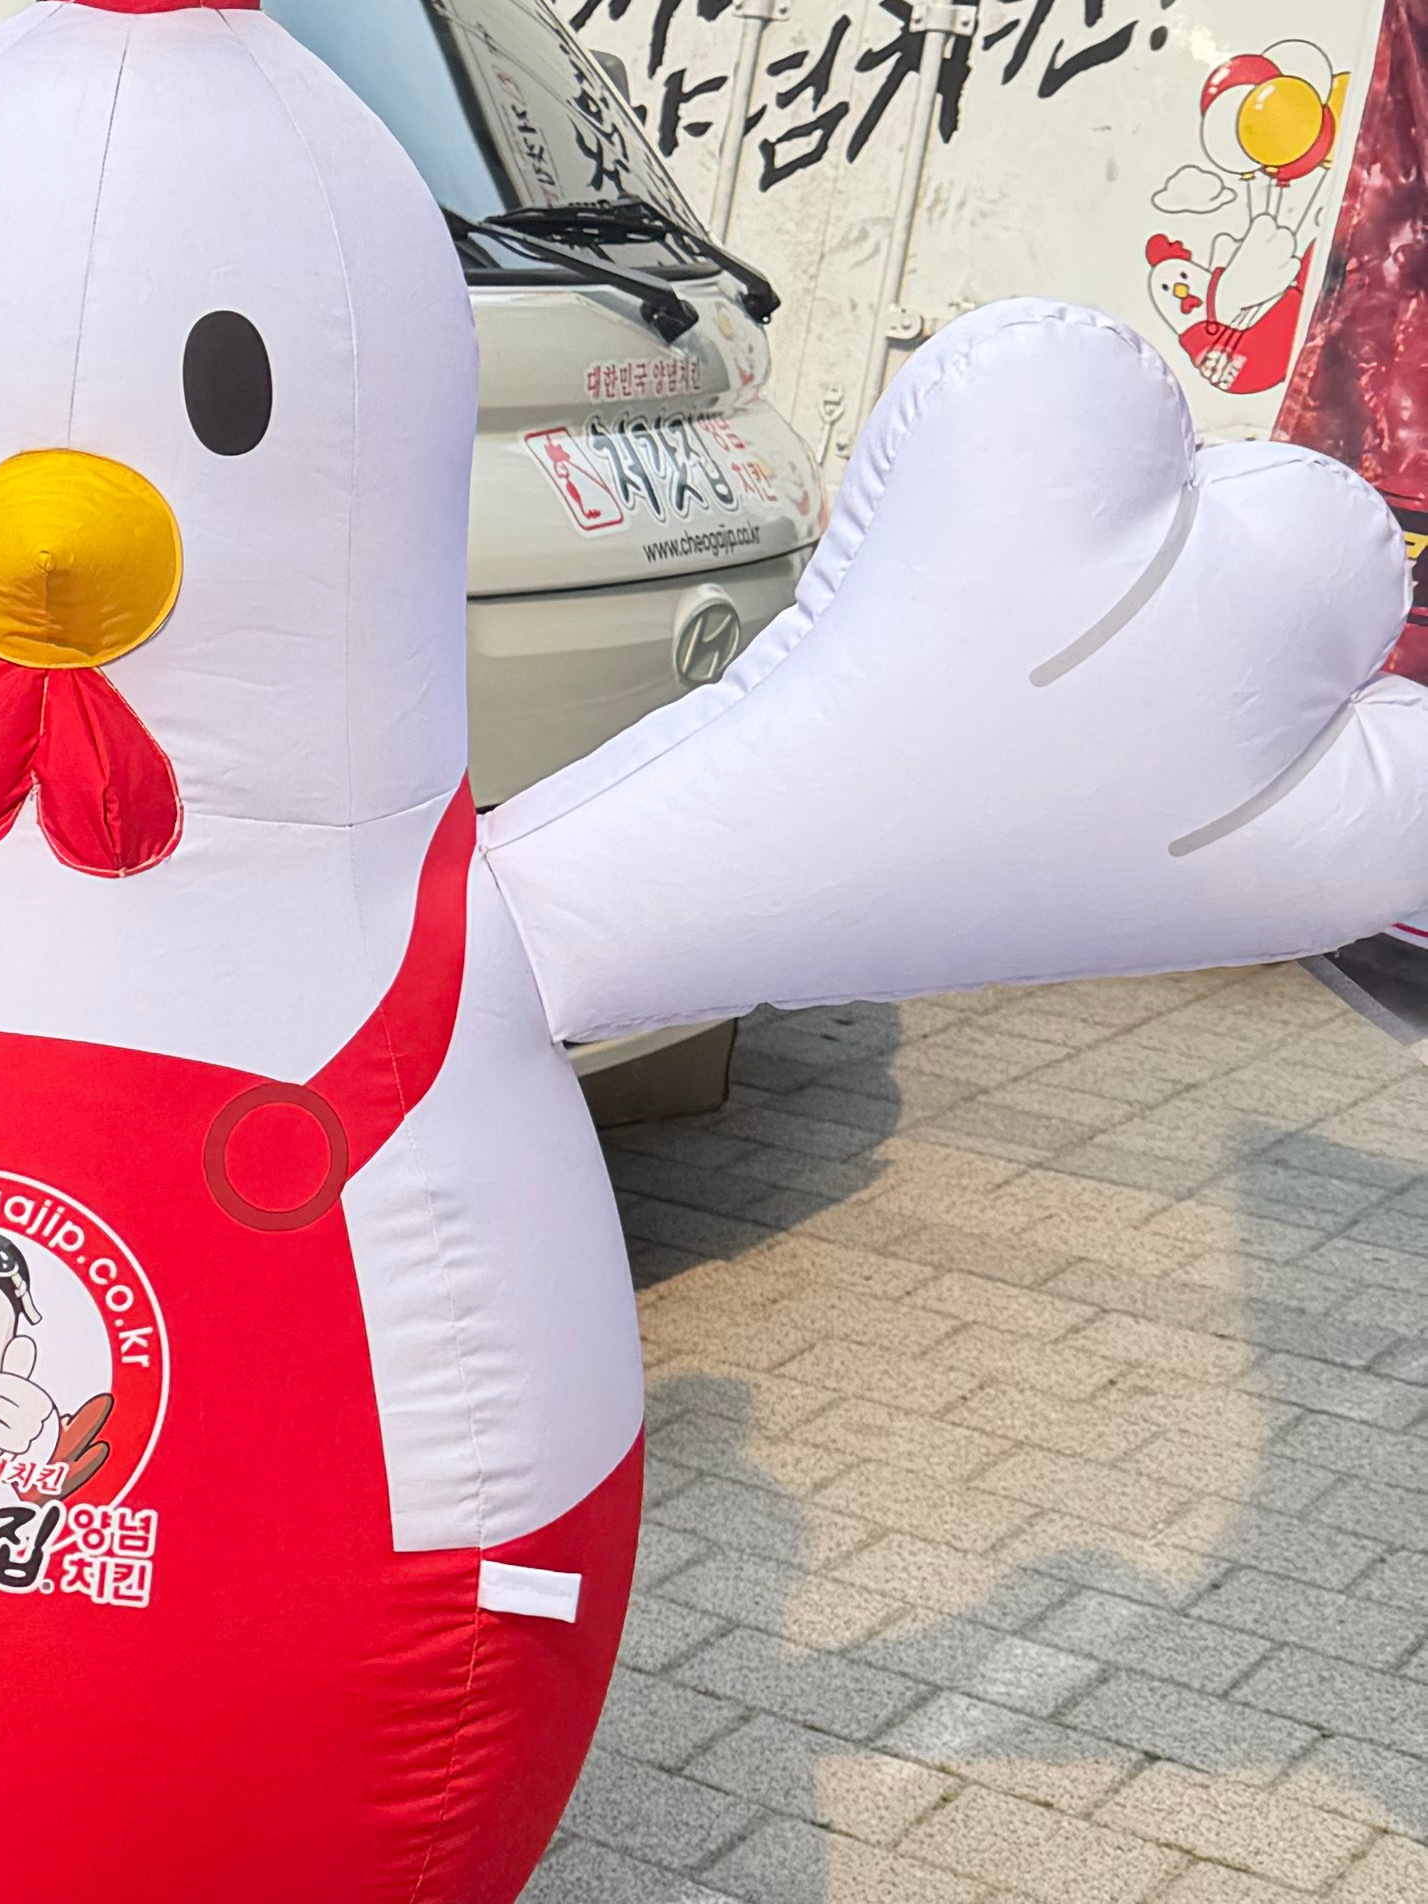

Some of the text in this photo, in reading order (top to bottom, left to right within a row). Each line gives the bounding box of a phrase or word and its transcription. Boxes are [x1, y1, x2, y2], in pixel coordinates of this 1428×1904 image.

[586, 358, 702, 399] 대한민국 양념치킨
[694, 410, 747, 452] 양념
[589, 414, 735, 516] 처갓집
[730, 461, 779, 503] 치킨
[642, 524, 761, 563] www.cheogajip.co.kr
[68, 1508, 156, 1556] 양념
[61, 1556, 152, 1607] 치킨
